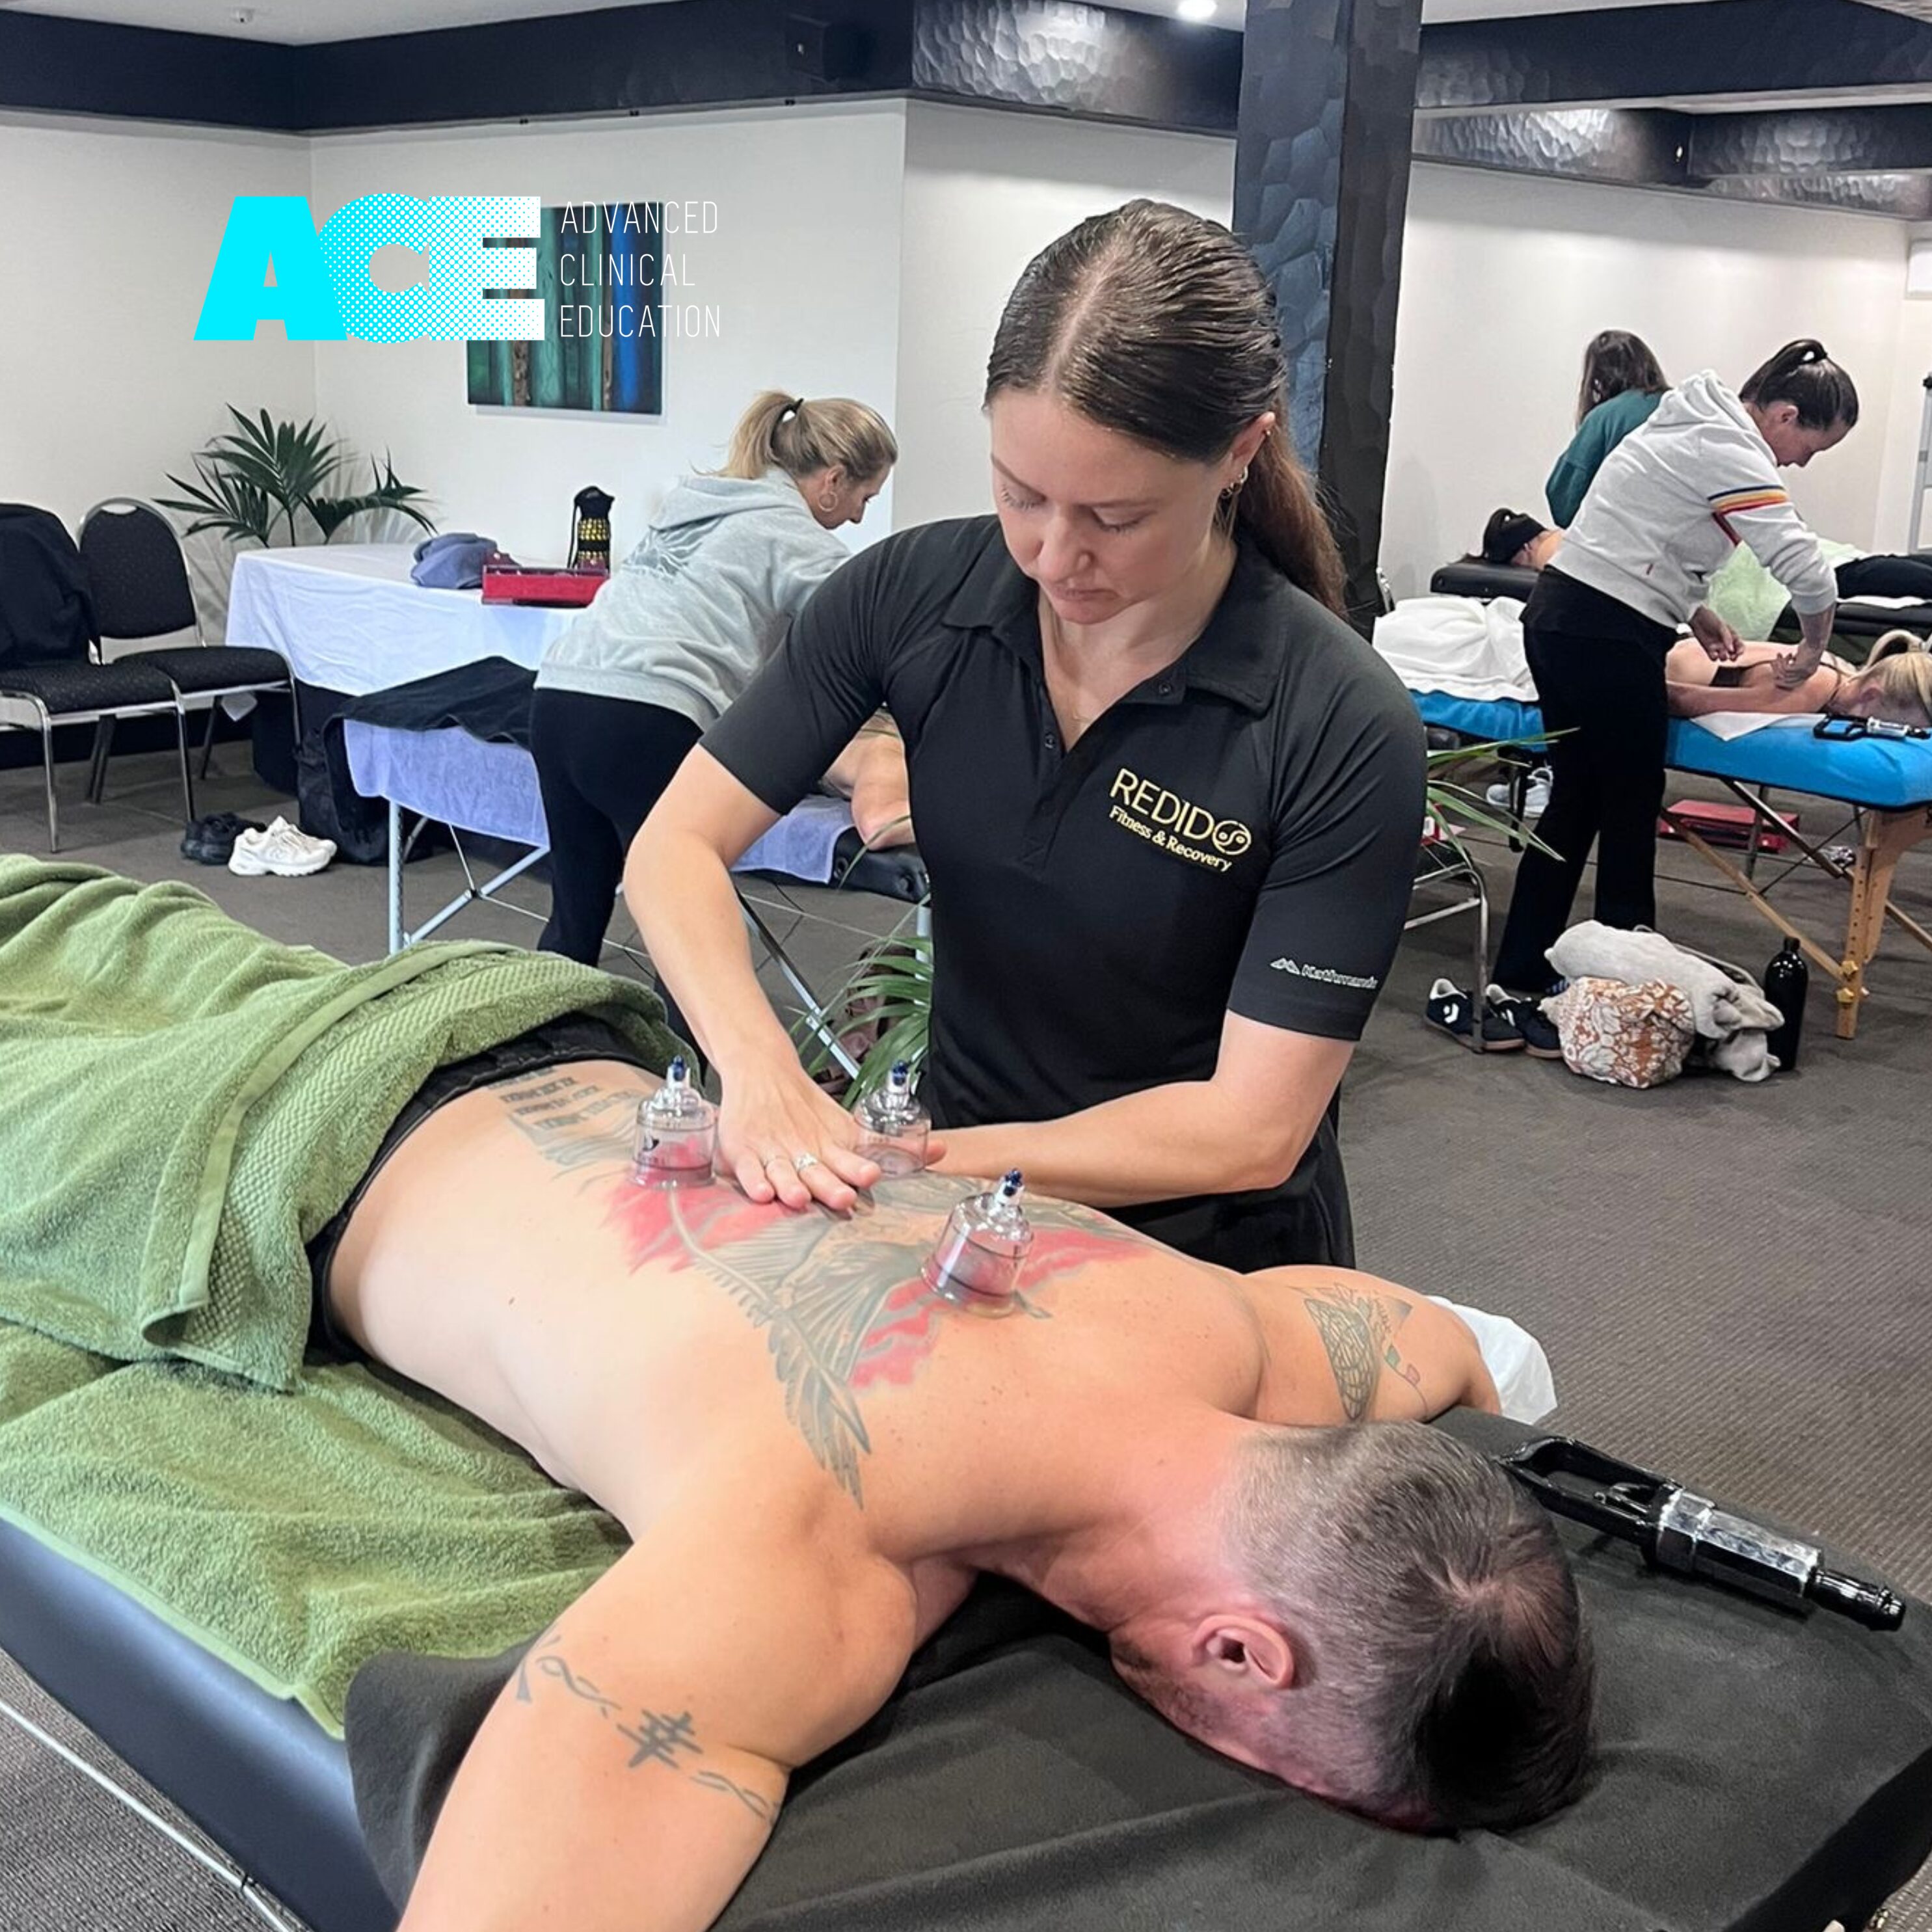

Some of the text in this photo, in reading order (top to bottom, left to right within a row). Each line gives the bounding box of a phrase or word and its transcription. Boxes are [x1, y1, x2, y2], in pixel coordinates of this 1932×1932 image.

[1110, 805, 1232, 872] Fitness & Recovery
